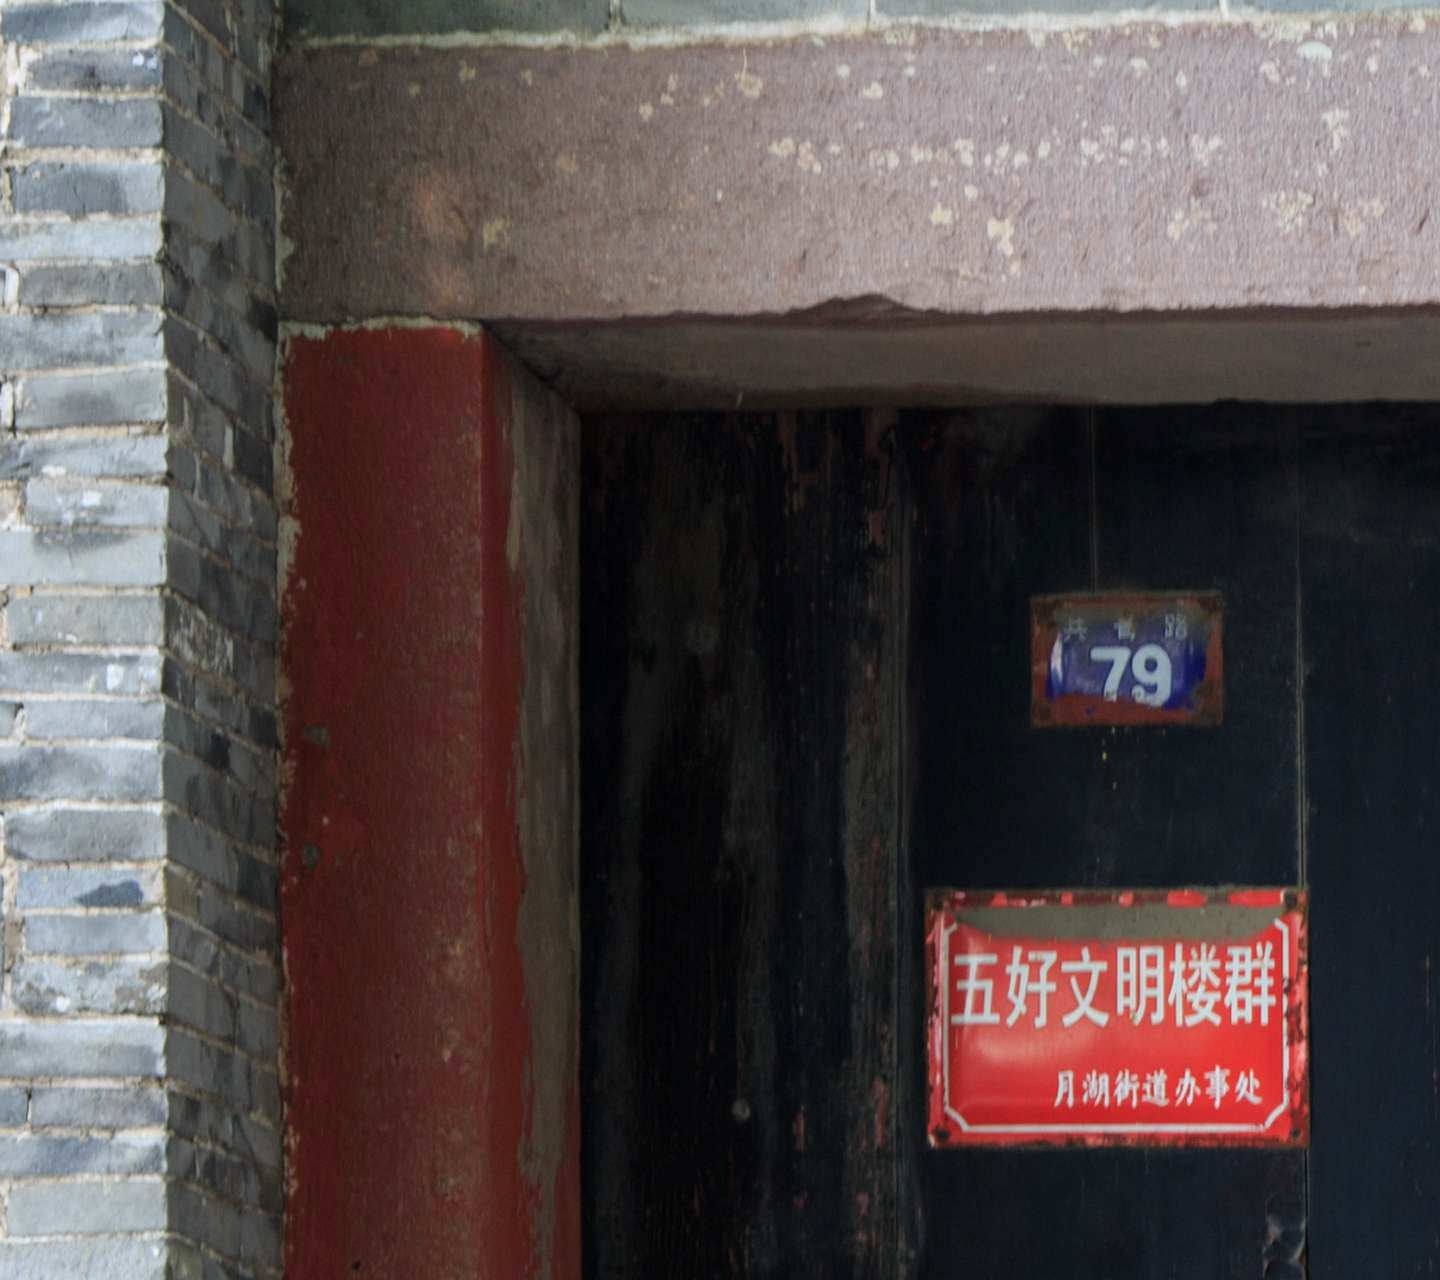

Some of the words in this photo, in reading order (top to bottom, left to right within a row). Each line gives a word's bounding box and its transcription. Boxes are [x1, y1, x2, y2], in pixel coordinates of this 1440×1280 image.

[1090, 644, 1172, 708] 79
[951, 942, 1278, 1029] 五好文明楼群
[1054, 1066, 1263, 1108] 月湖街道办事处
